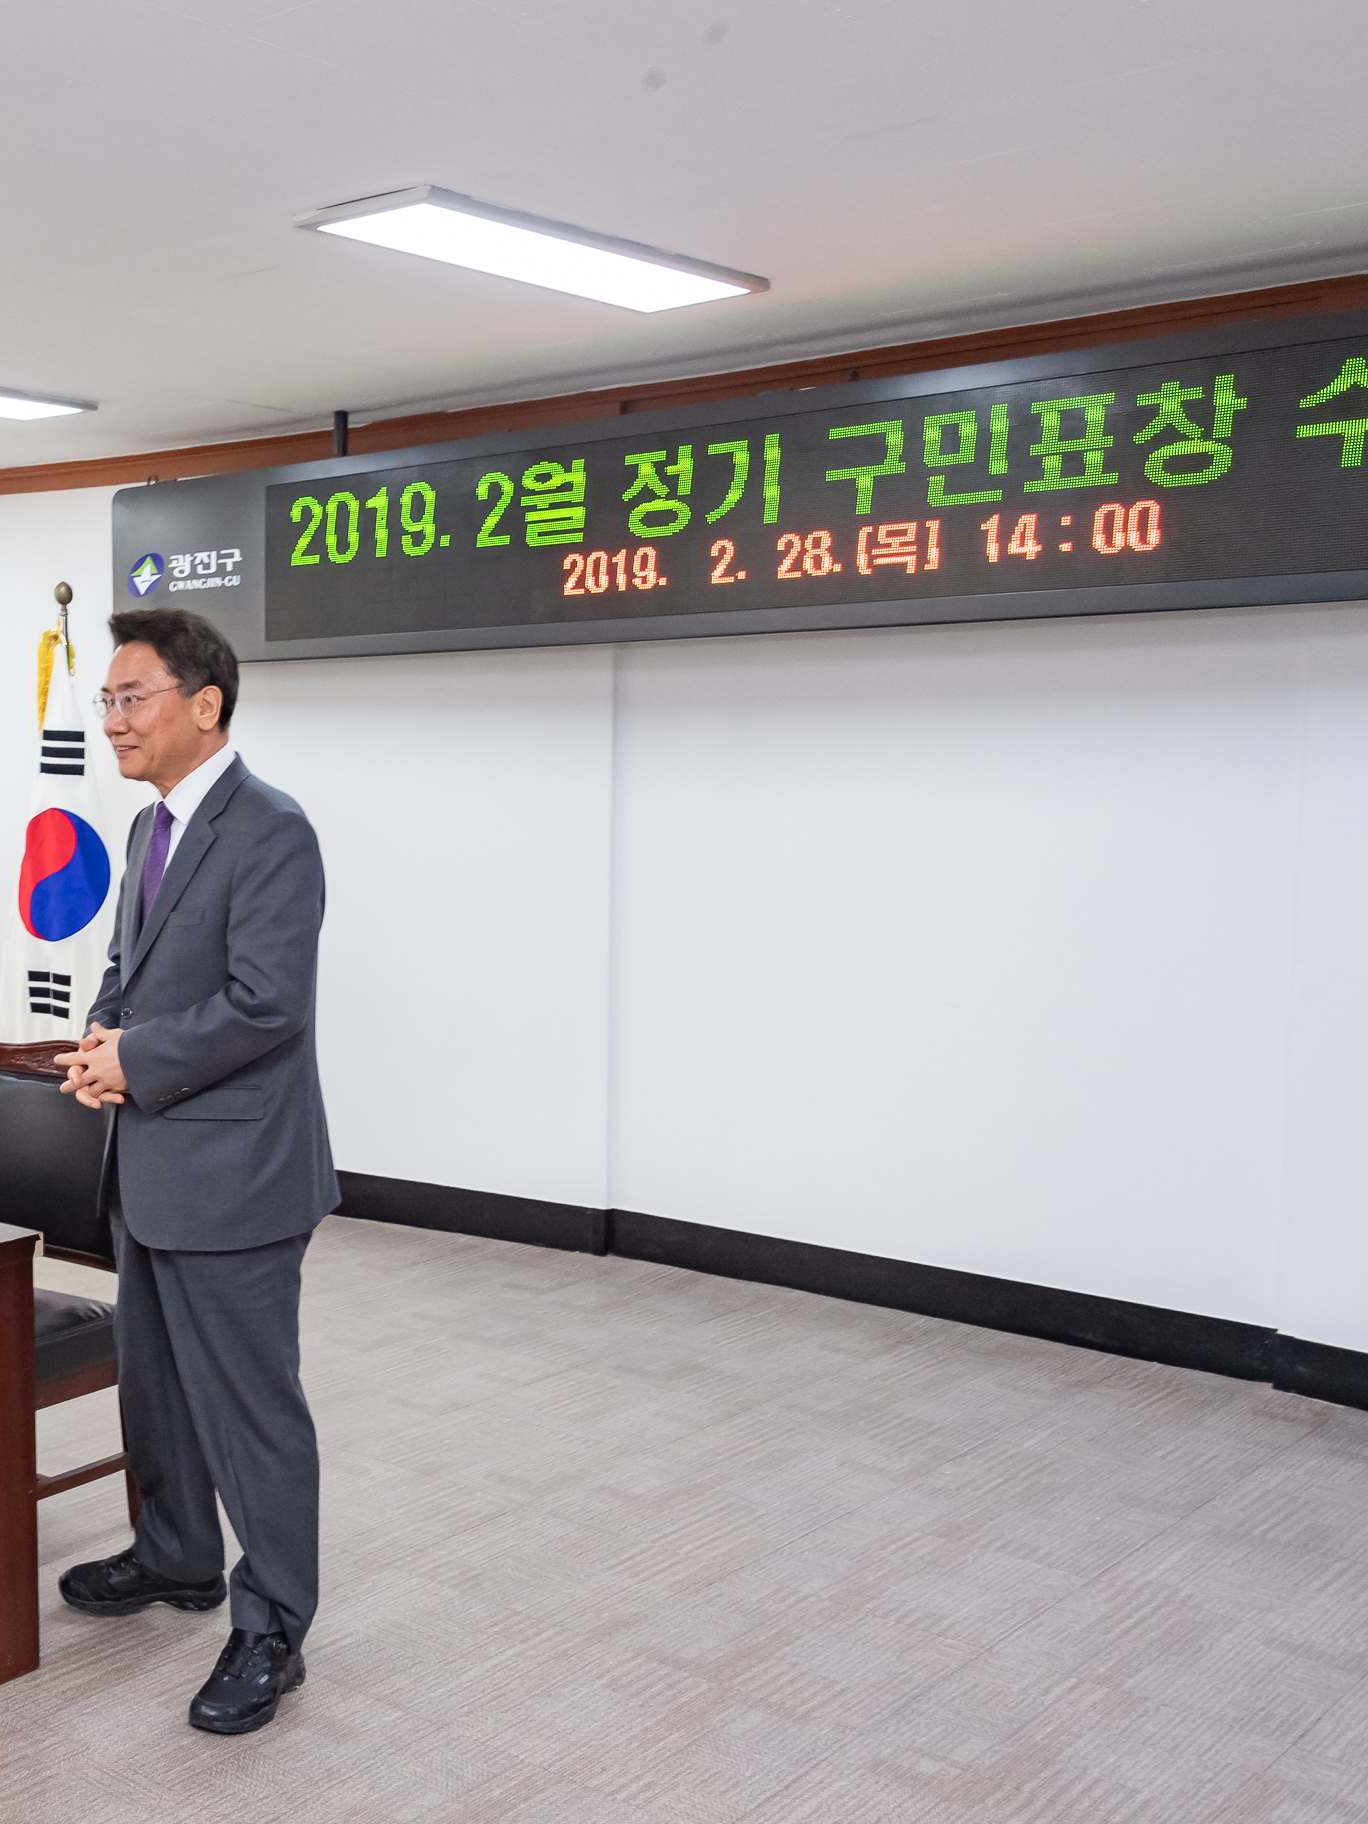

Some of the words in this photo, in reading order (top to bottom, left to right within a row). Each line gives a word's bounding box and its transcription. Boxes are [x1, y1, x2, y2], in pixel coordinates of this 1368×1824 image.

[288, 480, 452, 567] 2019.
[475, 457, 587, 548] 2월
[621, 432, 783, 539] 정기
[825, 373, 1249, 515] 구민표창
[167, 548, 243, 578] 광진구
[168, 574, 242, 592] GWANGJIN-GU
[562, 545, 668, 596] 2019.
[710, 538, 747, 585] 2.
